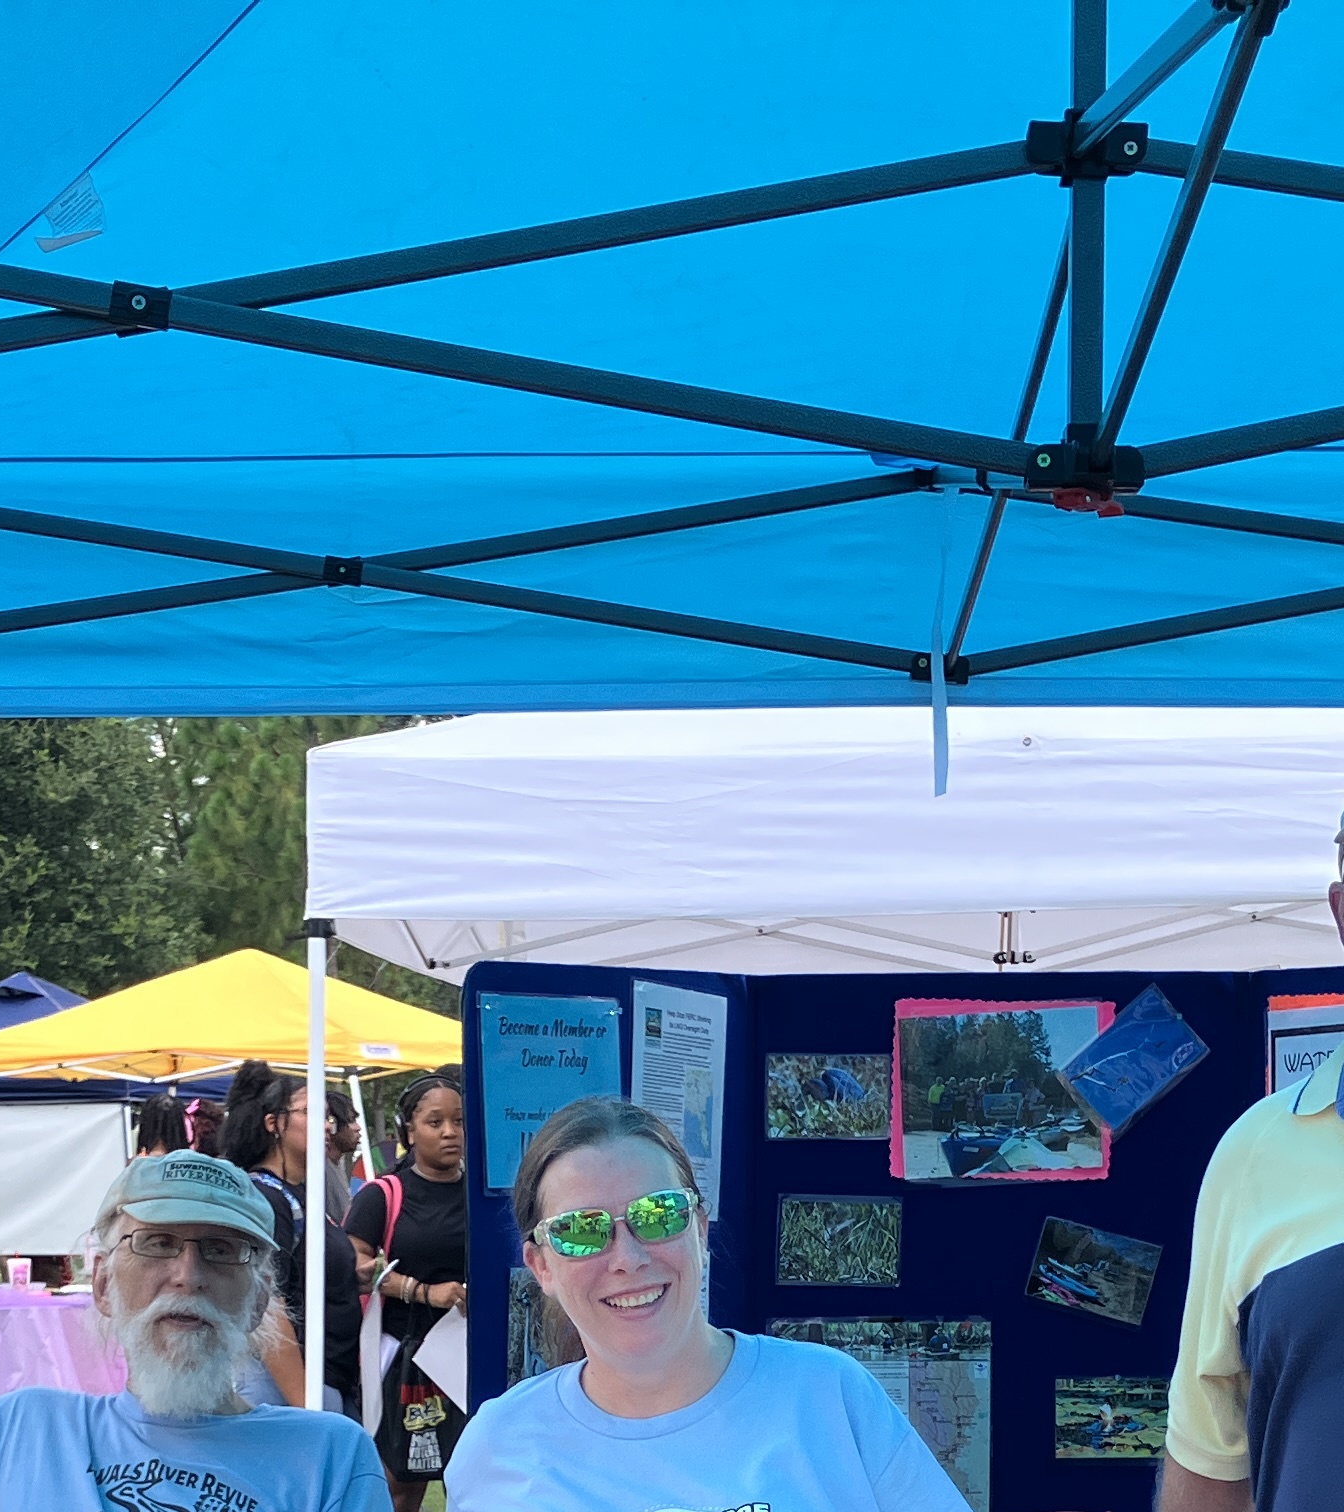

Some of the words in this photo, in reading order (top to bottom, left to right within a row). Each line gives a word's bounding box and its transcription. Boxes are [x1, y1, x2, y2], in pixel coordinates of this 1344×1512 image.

[498, 1016, 540, 1037] Become
[542, 1026, 549, 1036] a
[551, 1019, 594, 1039] Member
[595, 1026, 607, 1038] or
[522, 1049, 554, 1068] Donor
[557, 1048, 589, 1075] Today
[87, 1459, 143, 1486] WALS
[145, 1458, 198, 1489] RIVER
